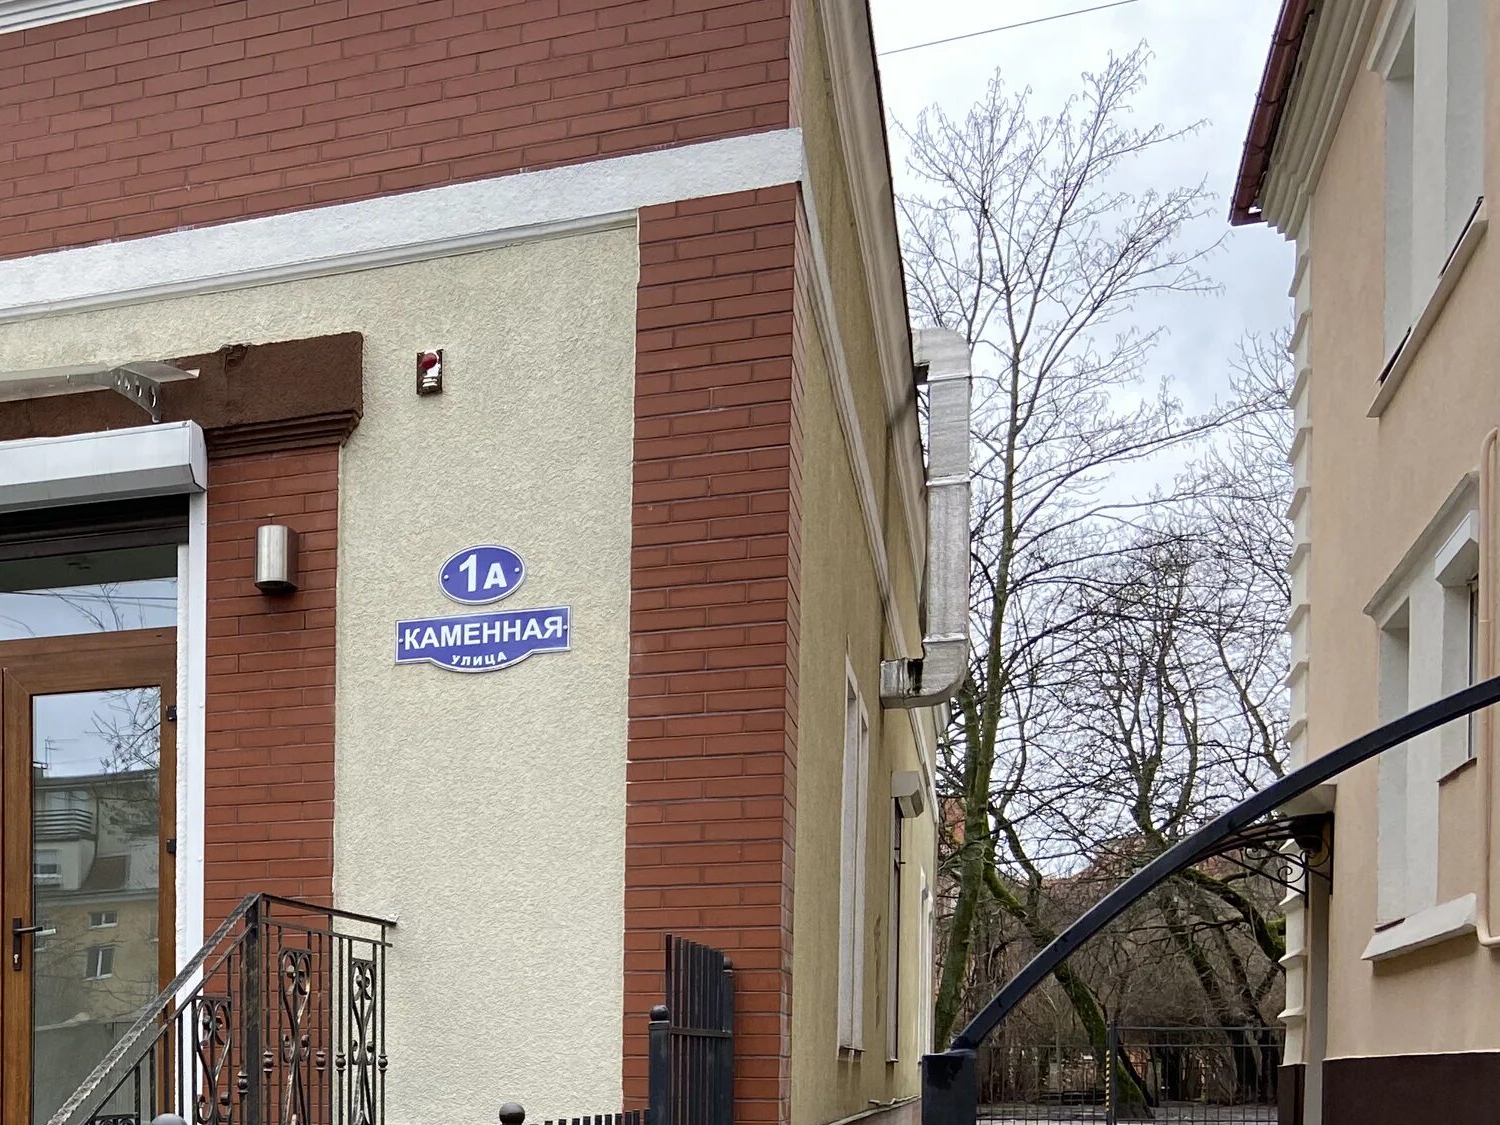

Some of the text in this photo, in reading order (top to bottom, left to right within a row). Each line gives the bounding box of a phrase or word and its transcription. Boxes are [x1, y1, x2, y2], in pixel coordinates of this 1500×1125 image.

[458, 553, 507, 593] 1А
[404, 615, 563, 651] КАМЕННАЯ
[451, 651, 508, 666] УЛИЦА
